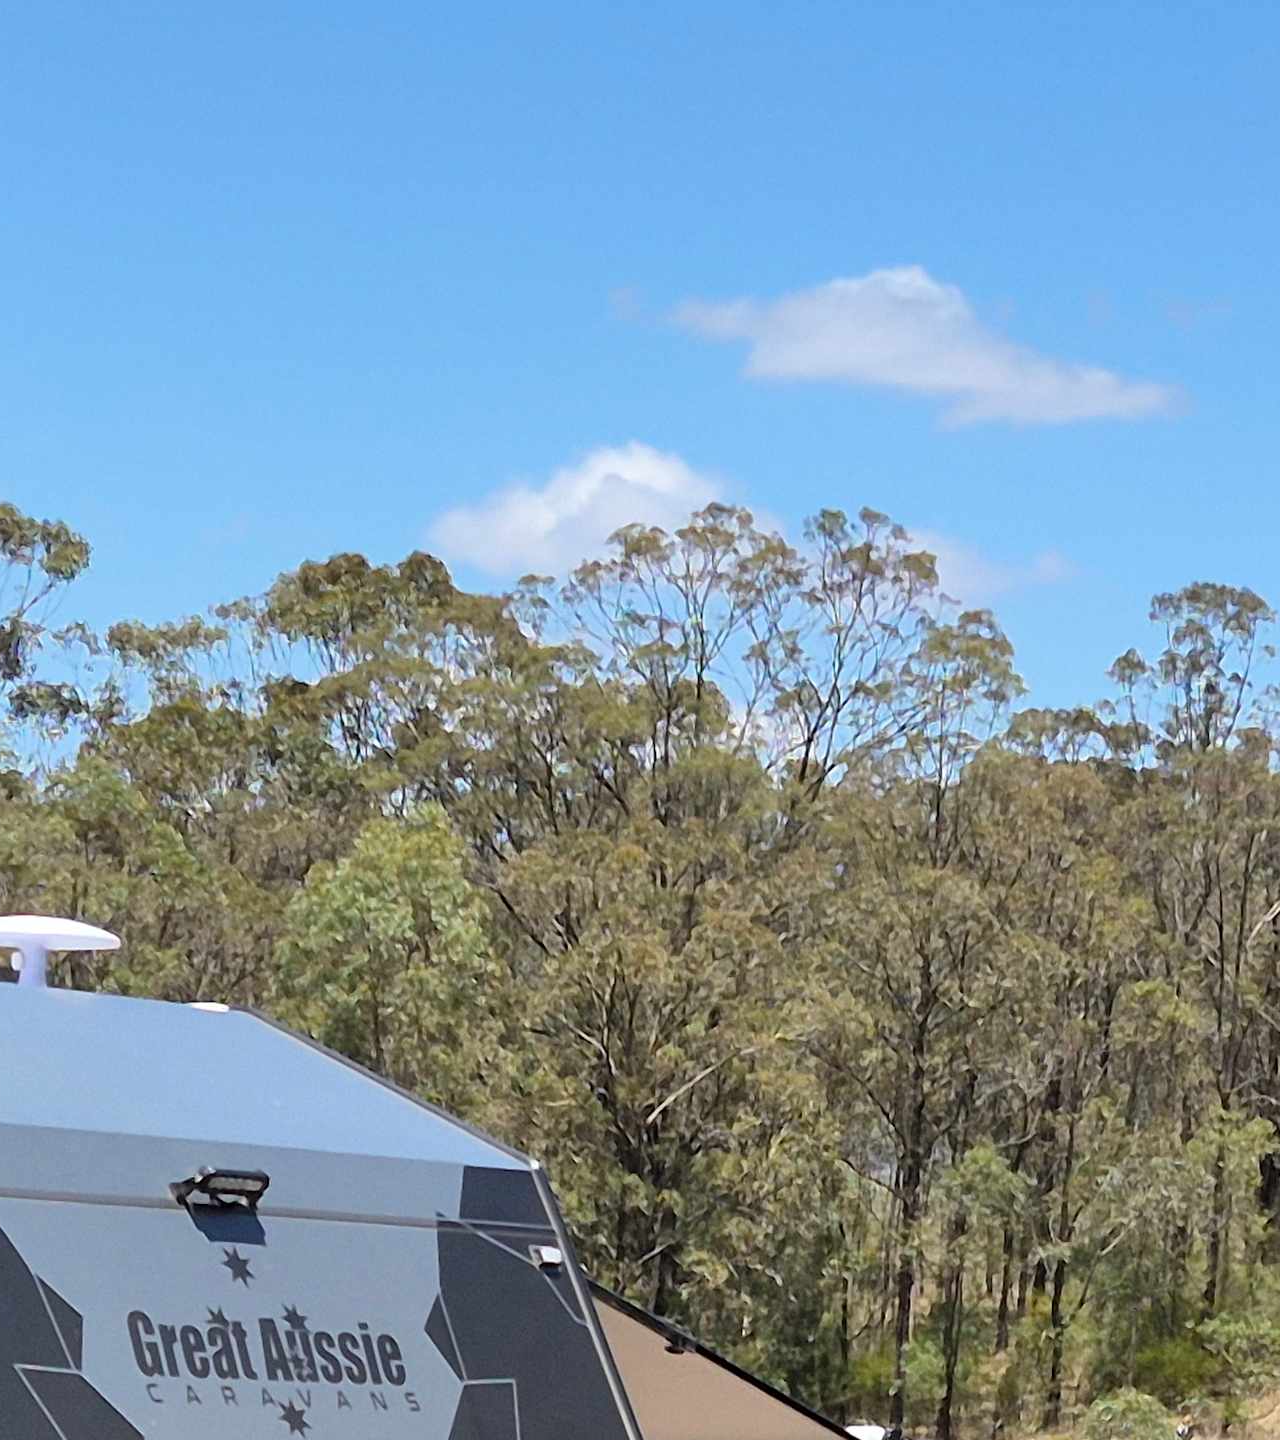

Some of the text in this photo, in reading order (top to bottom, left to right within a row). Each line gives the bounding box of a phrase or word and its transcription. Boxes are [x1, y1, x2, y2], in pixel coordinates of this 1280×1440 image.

[127, 1309, 407, 1386] Great Aussie
[146, 1383, 421, 1412] CARAVANS
